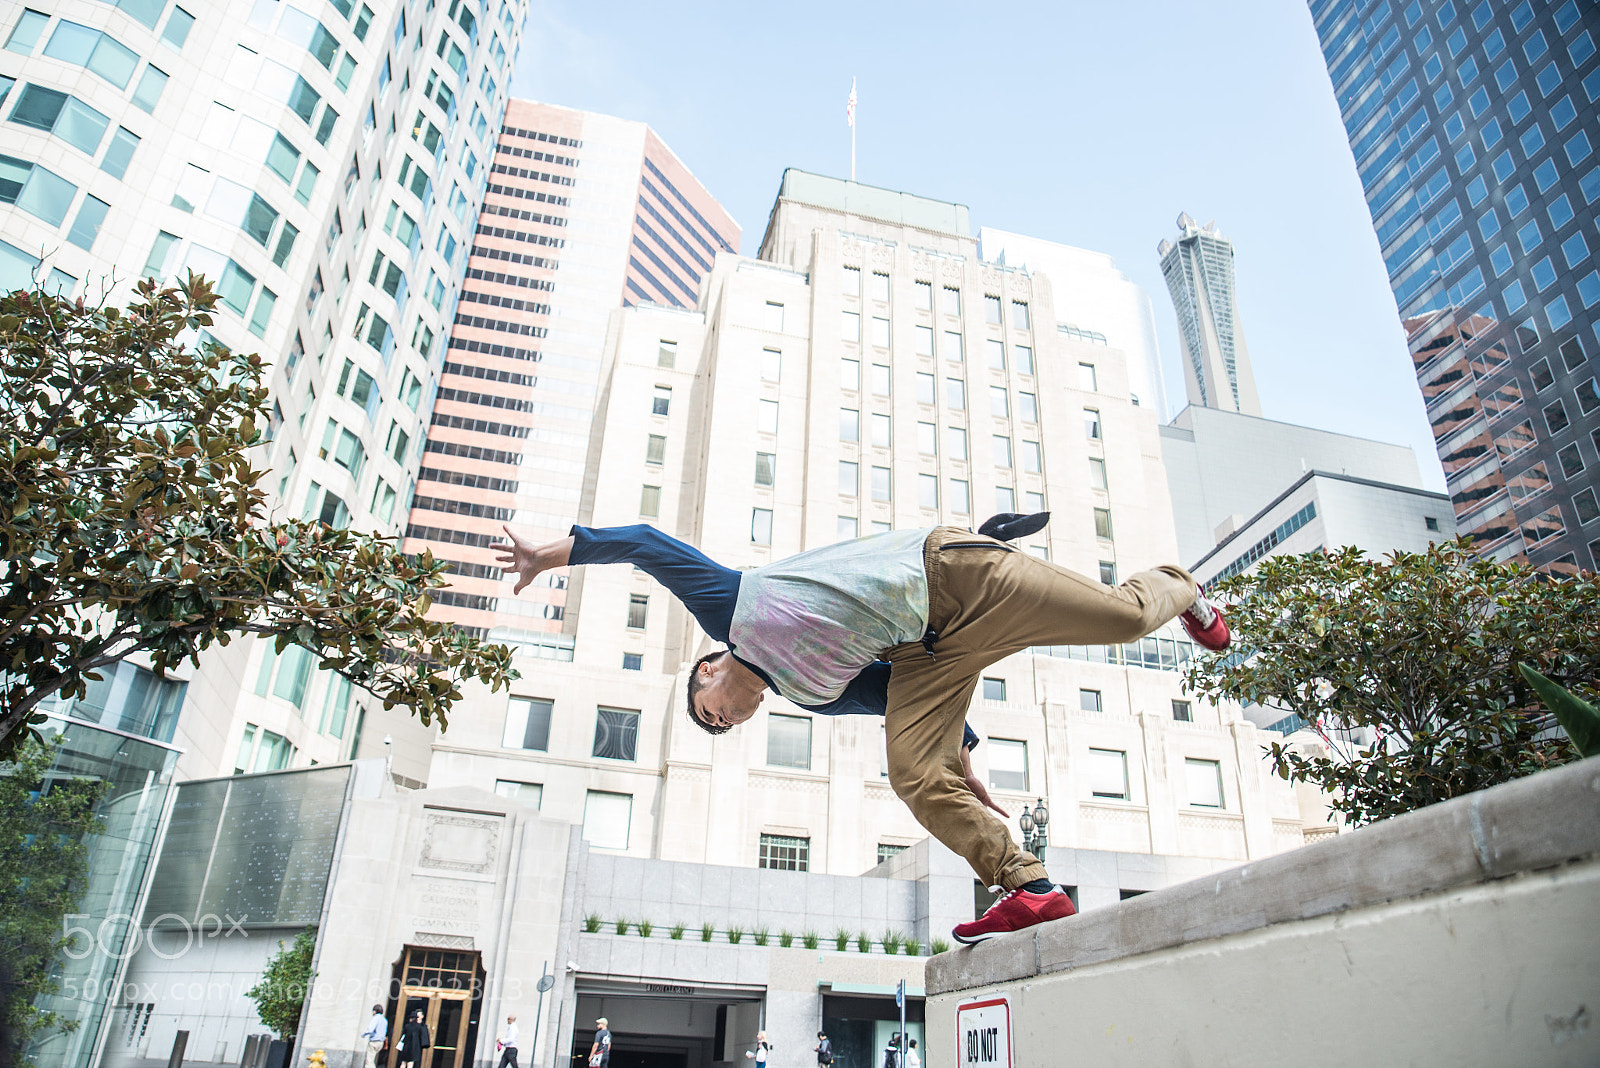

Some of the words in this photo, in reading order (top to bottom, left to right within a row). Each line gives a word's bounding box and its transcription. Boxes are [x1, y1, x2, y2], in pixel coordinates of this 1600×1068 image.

[422, 894, 479, 908] CALIFORNIA
[412, 918, 460, 929] COMPANY
[967, 1029, 979, 1063] DO
[981, 1027, 998, 1062] NOT
